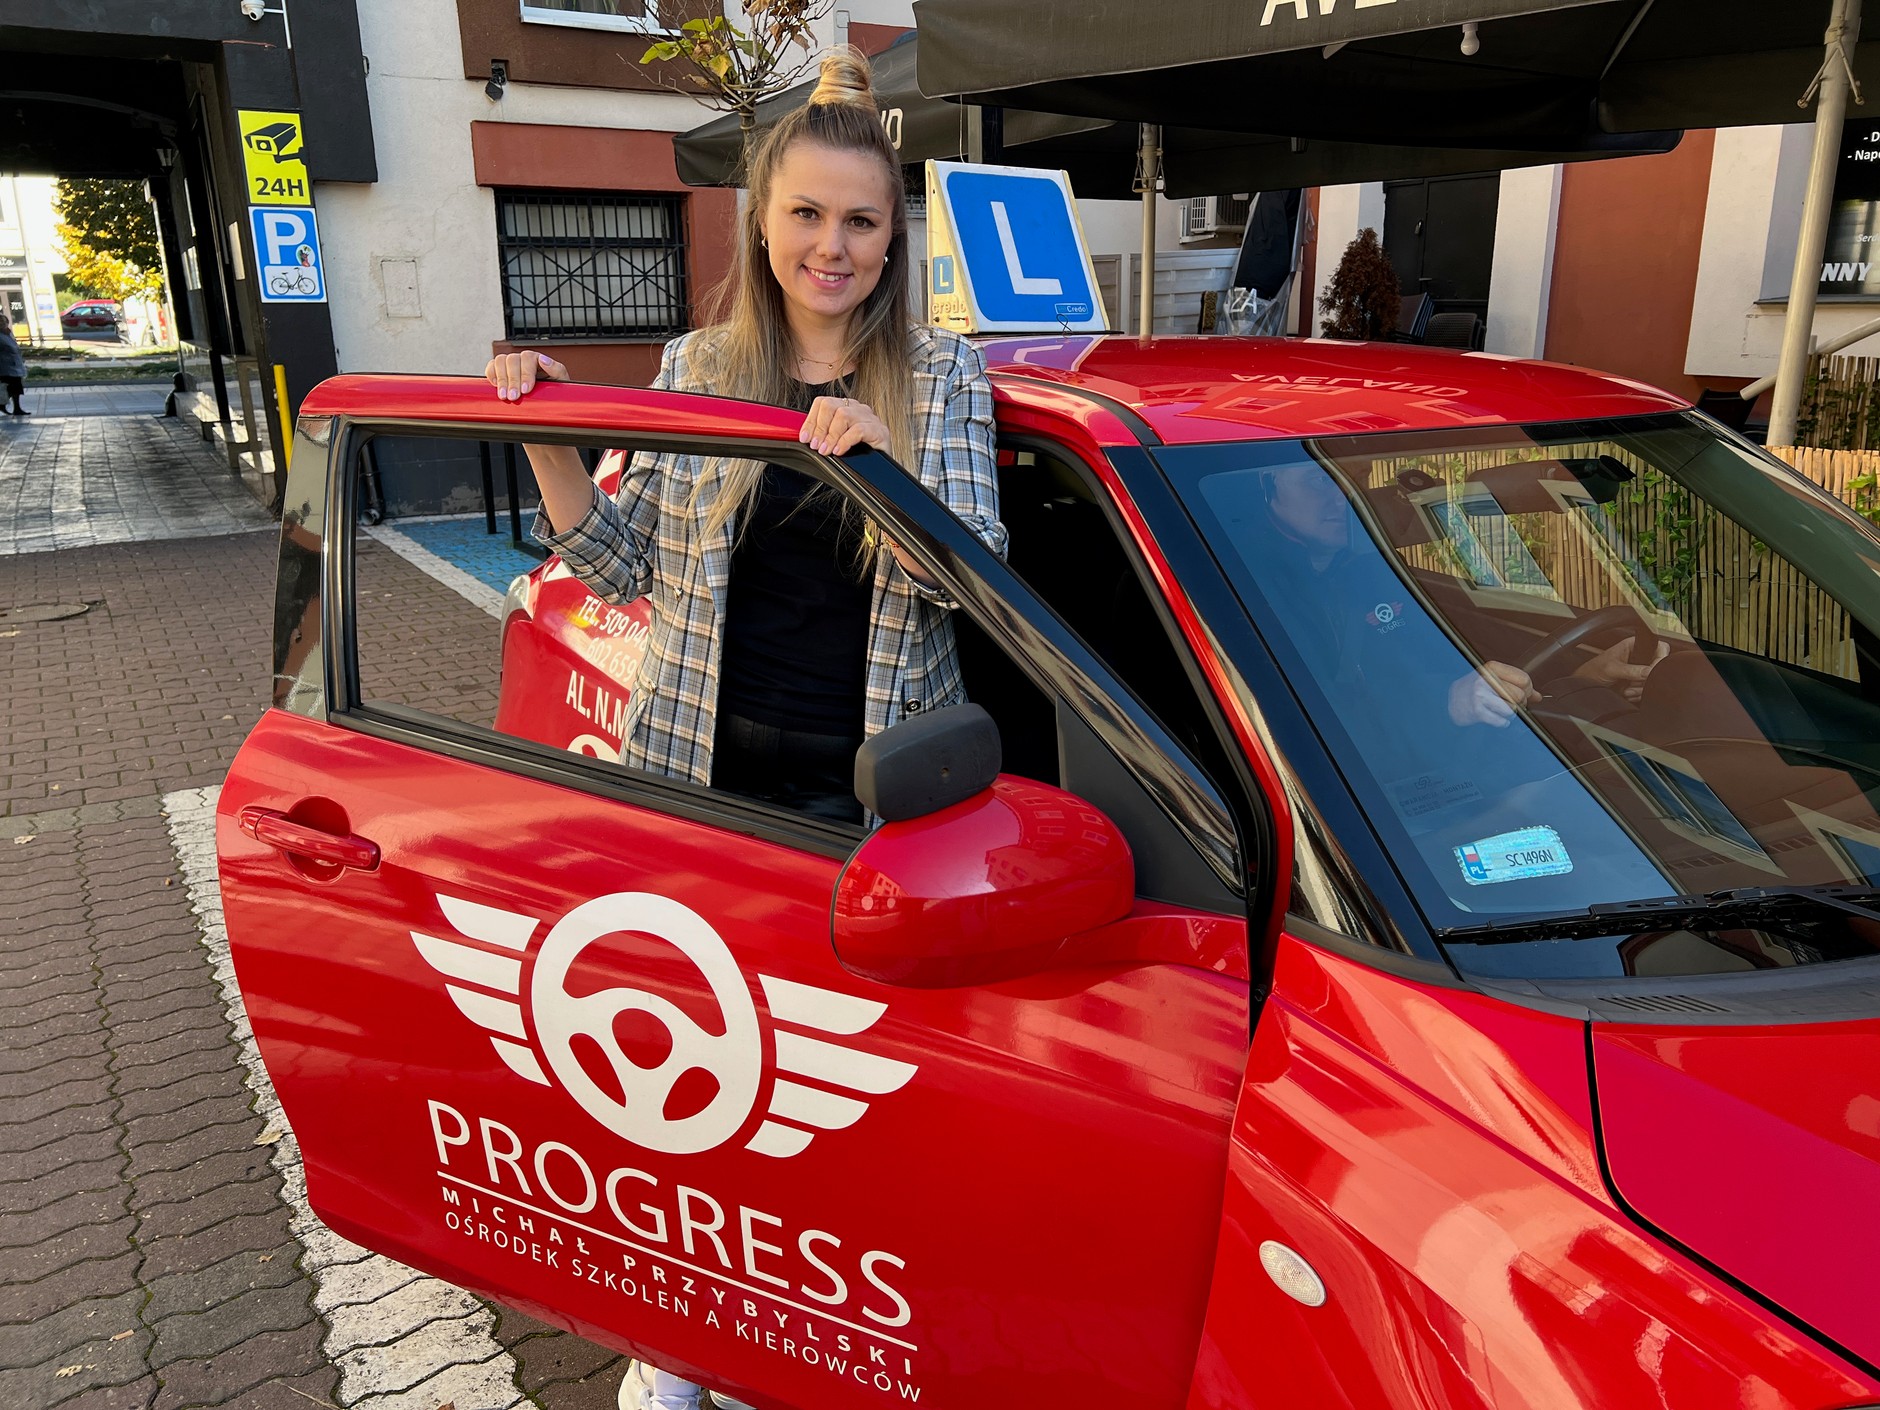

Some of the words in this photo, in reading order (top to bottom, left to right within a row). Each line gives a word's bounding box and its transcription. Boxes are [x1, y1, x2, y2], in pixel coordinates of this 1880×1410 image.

[1870, 131, 1880, 142] D
[255, 177, 304, 197] 24H
[263, 213, 306, 264] P
[990, 201, 1063, 295] L
[938, 263, 949, 287] L
[1820, 262, 1873, 282] NNY
[931, 298, 967, 314] credo
[1067, 305, 1087, 313] Credo
[577, 595, 602, 627] TEL.
[599, 608, 630, 638] 509
[588, 637, 612, 669] 602
[609, 651, 637, 683] 659
[566, 670, 591, 719] AL.
[1470, 866, 1484, 875] PL
[428, 1100, 912, 1328] PROGRESS
[441, 1186, 590, 1256] MICHAŁ
[622, 1254, 911, 1376] PRZYBYLSKI
[445, 1211, 559, 1269] OŚRODEK
[571, 1258, 689, 1317] SZKOLEN
[705, 1309, 721, 1329] A
[735, 1319, 921, 1403] KIEROWCÓW
